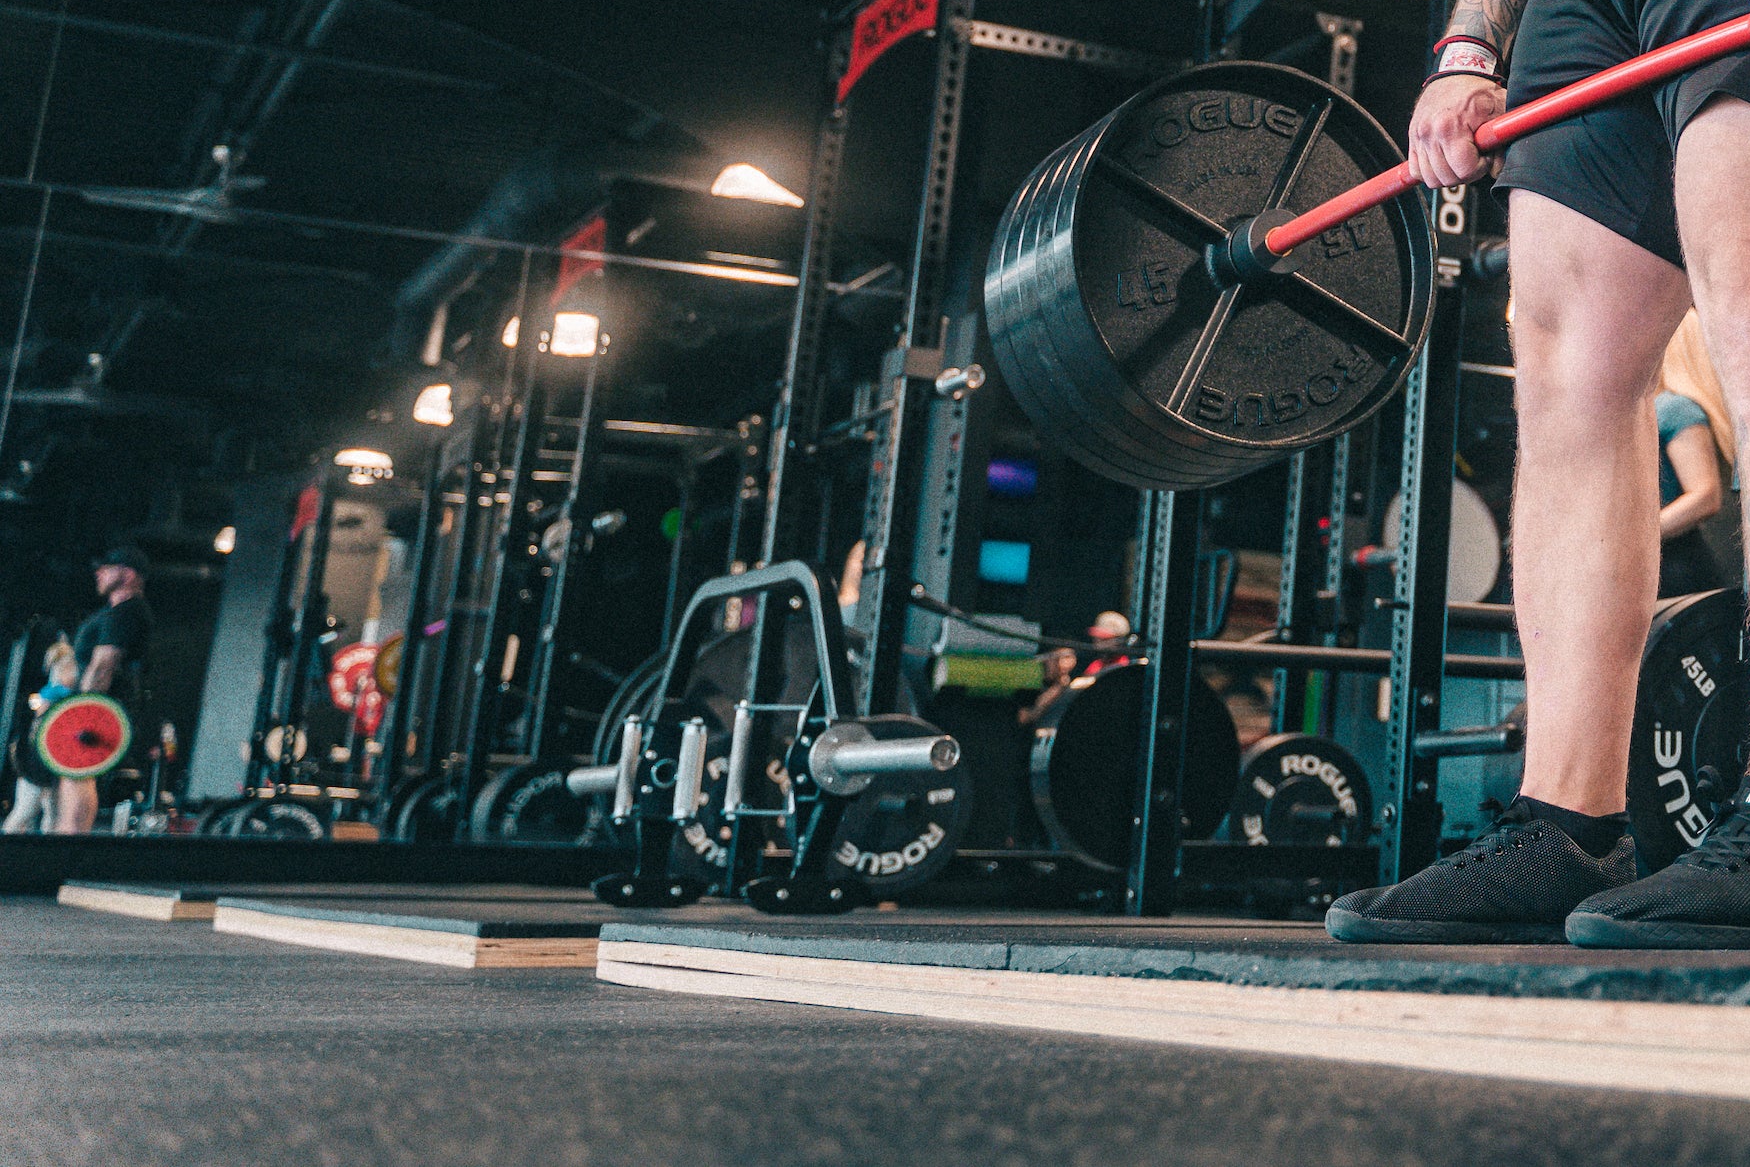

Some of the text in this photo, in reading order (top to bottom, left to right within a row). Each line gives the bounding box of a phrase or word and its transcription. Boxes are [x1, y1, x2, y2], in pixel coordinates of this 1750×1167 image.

[1151, 97, 1303, 148] OGUE
[1117, 261, 1177, 312] 45
[1681, 655, 1716, 697] 45LB
[1281, 753, 1358, 817] ROGUE
[1654, 731, 1711, 848] GUE
[834, 821, 946, 876] ROGUE
